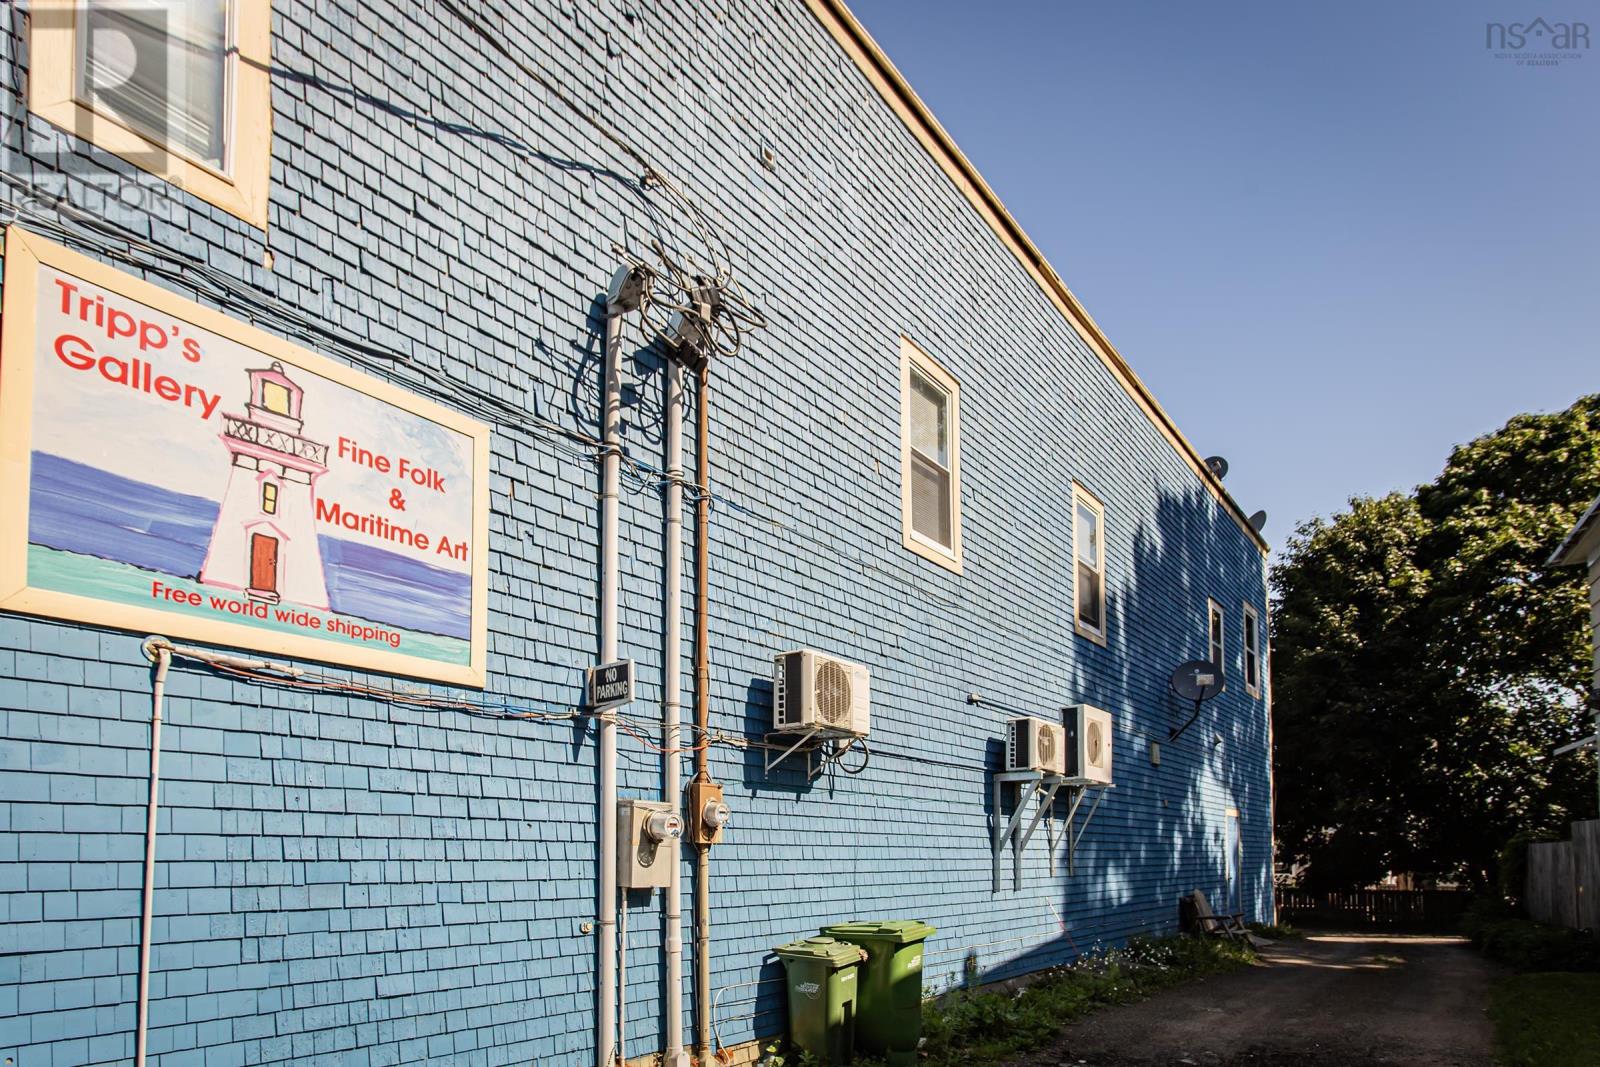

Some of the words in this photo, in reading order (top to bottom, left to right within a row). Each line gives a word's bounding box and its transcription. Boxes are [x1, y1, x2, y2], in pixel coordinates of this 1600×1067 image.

[54, 277, 202, 364] Tripp's
[53, 333, 222, 421] Gallery
[337, 436, 392, 475] Fine
[398, 457, 447, 493] Folk
[315, 497, 430, 551] Maritime
[435, 536, 468, 561] Art
[388, 487, 406, 512] &
[151, 580, 203, 607] Free
[209, 594, 269, 620] world
[274, 609, 321, 630] wide
[326, 618, 402, 648] shipping
[597, 681, 628, 699] PARKING
[605, 667, 617, 682] NO
